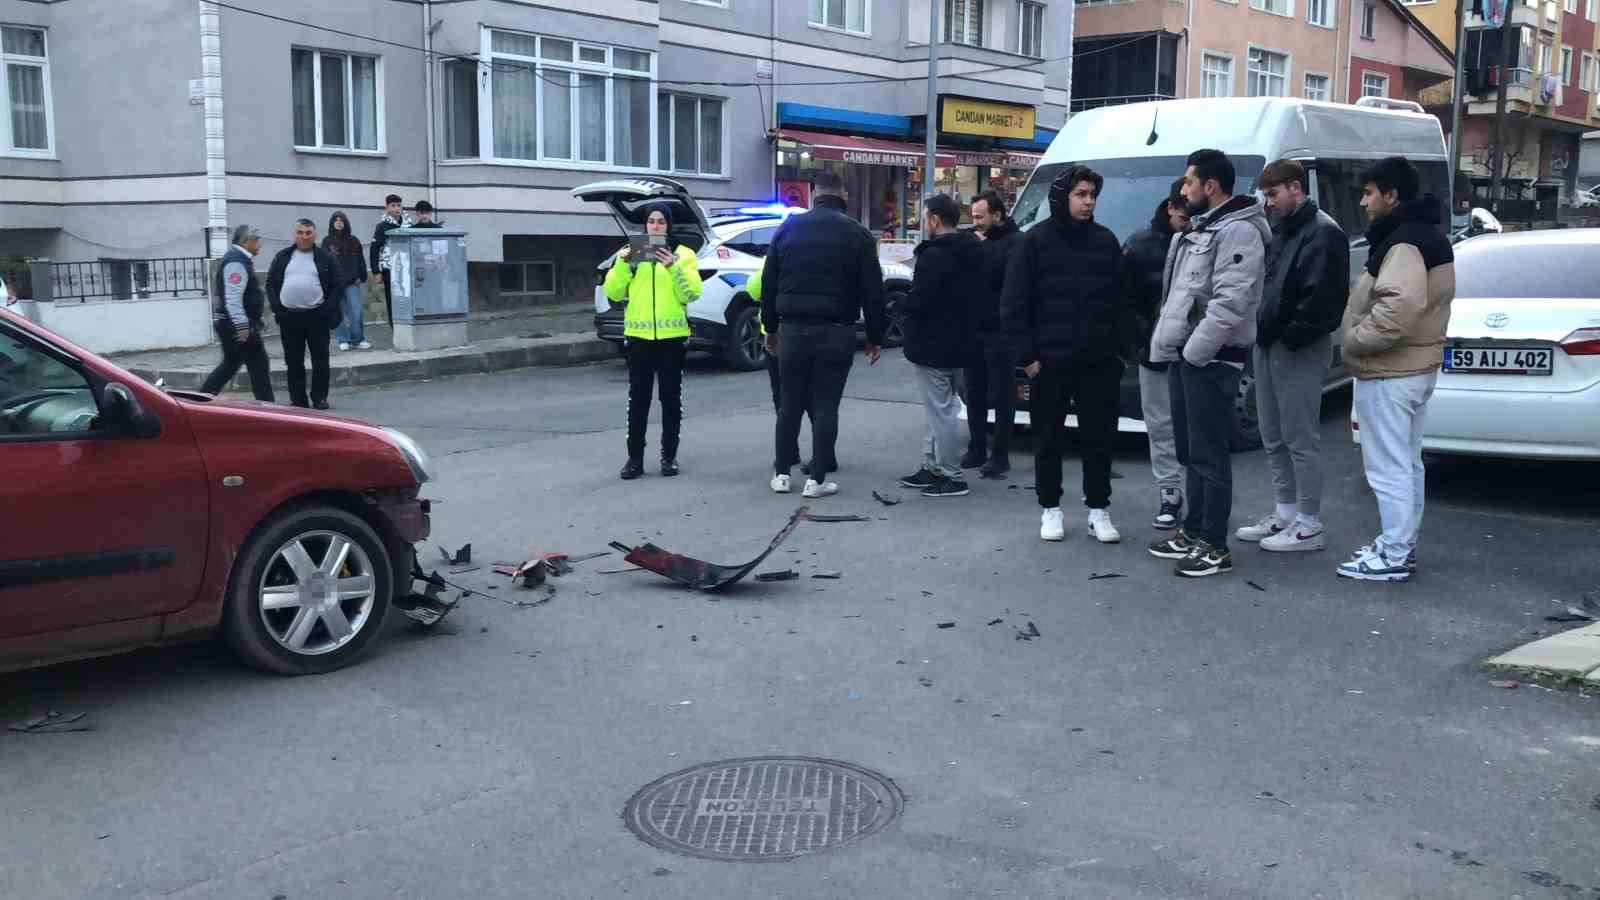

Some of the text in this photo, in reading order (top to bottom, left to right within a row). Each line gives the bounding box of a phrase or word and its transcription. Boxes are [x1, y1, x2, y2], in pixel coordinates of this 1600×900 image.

[955, 109, 985, 124] CANDAN
[986, 113, 1013, 128] MARKET
[842, 151, 918, 167] CANDAN MARKET
[1453, 350, 1474, 367] 59
[1479, 351, 1508, 367] AIJ
[1514, 351, 1547, 368] 402
[705, 801, 818, 813] TELEFON
